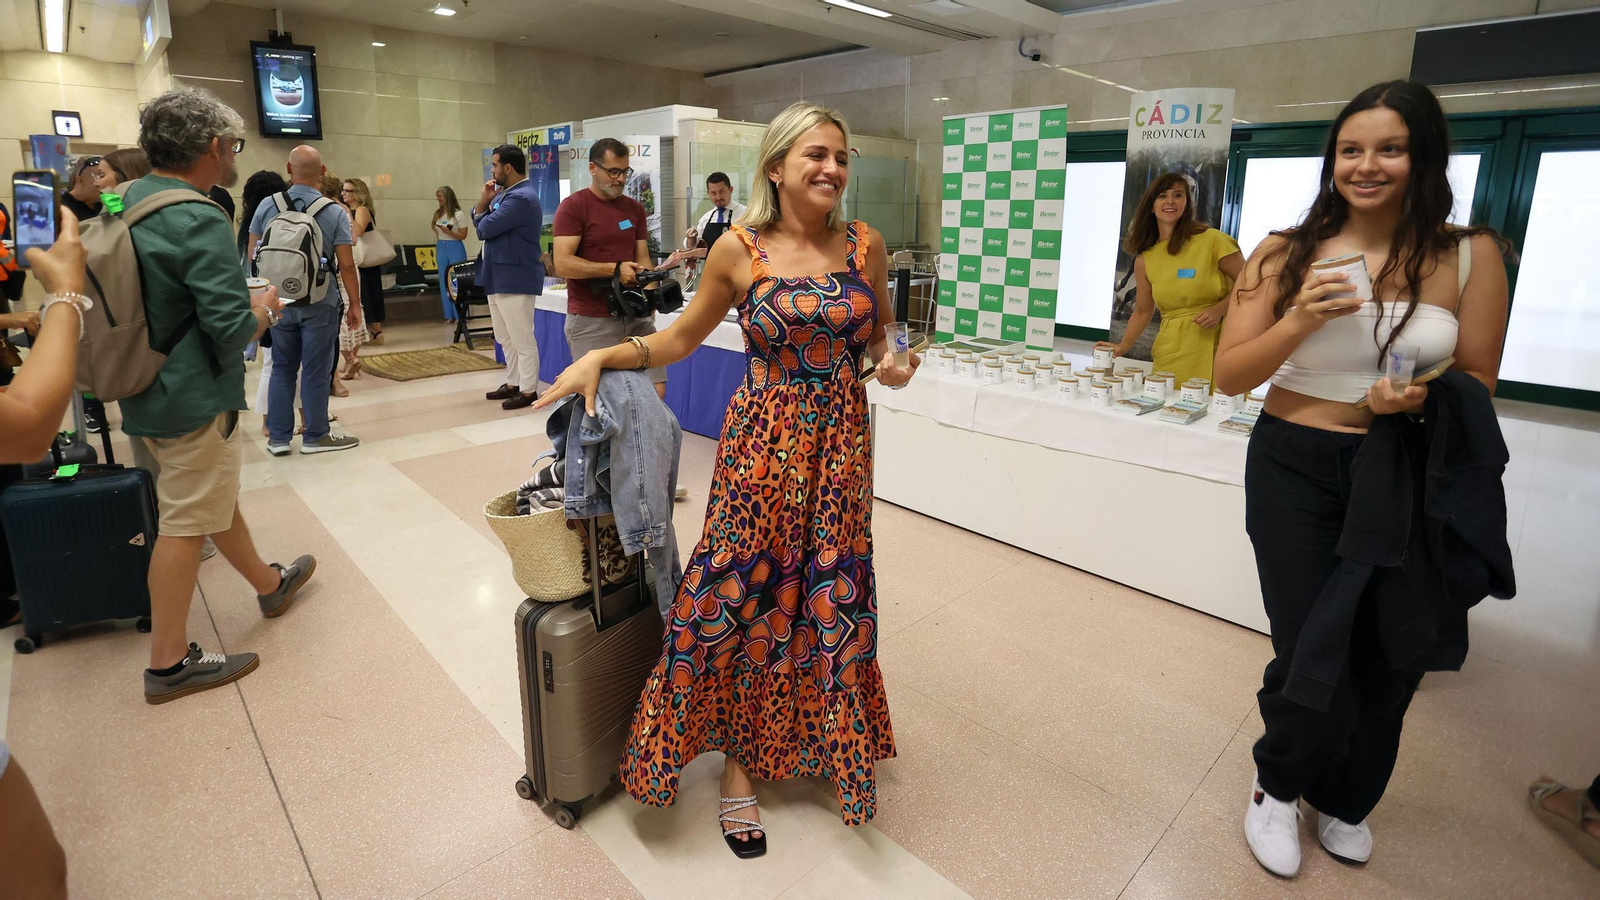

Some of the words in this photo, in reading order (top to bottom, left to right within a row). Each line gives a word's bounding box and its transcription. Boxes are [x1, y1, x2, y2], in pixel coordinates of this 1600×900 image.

[1135, 100, 1224, 127] CÁDIZ
[518, 133, 538, 148] Hertz
[1142, 129, 1206, 140] PROVINCIA
[528, 150, 554, 163] DIZ
[571, 148, 588, 160] DIZ
[628, 145, 651, 156] DIZ
